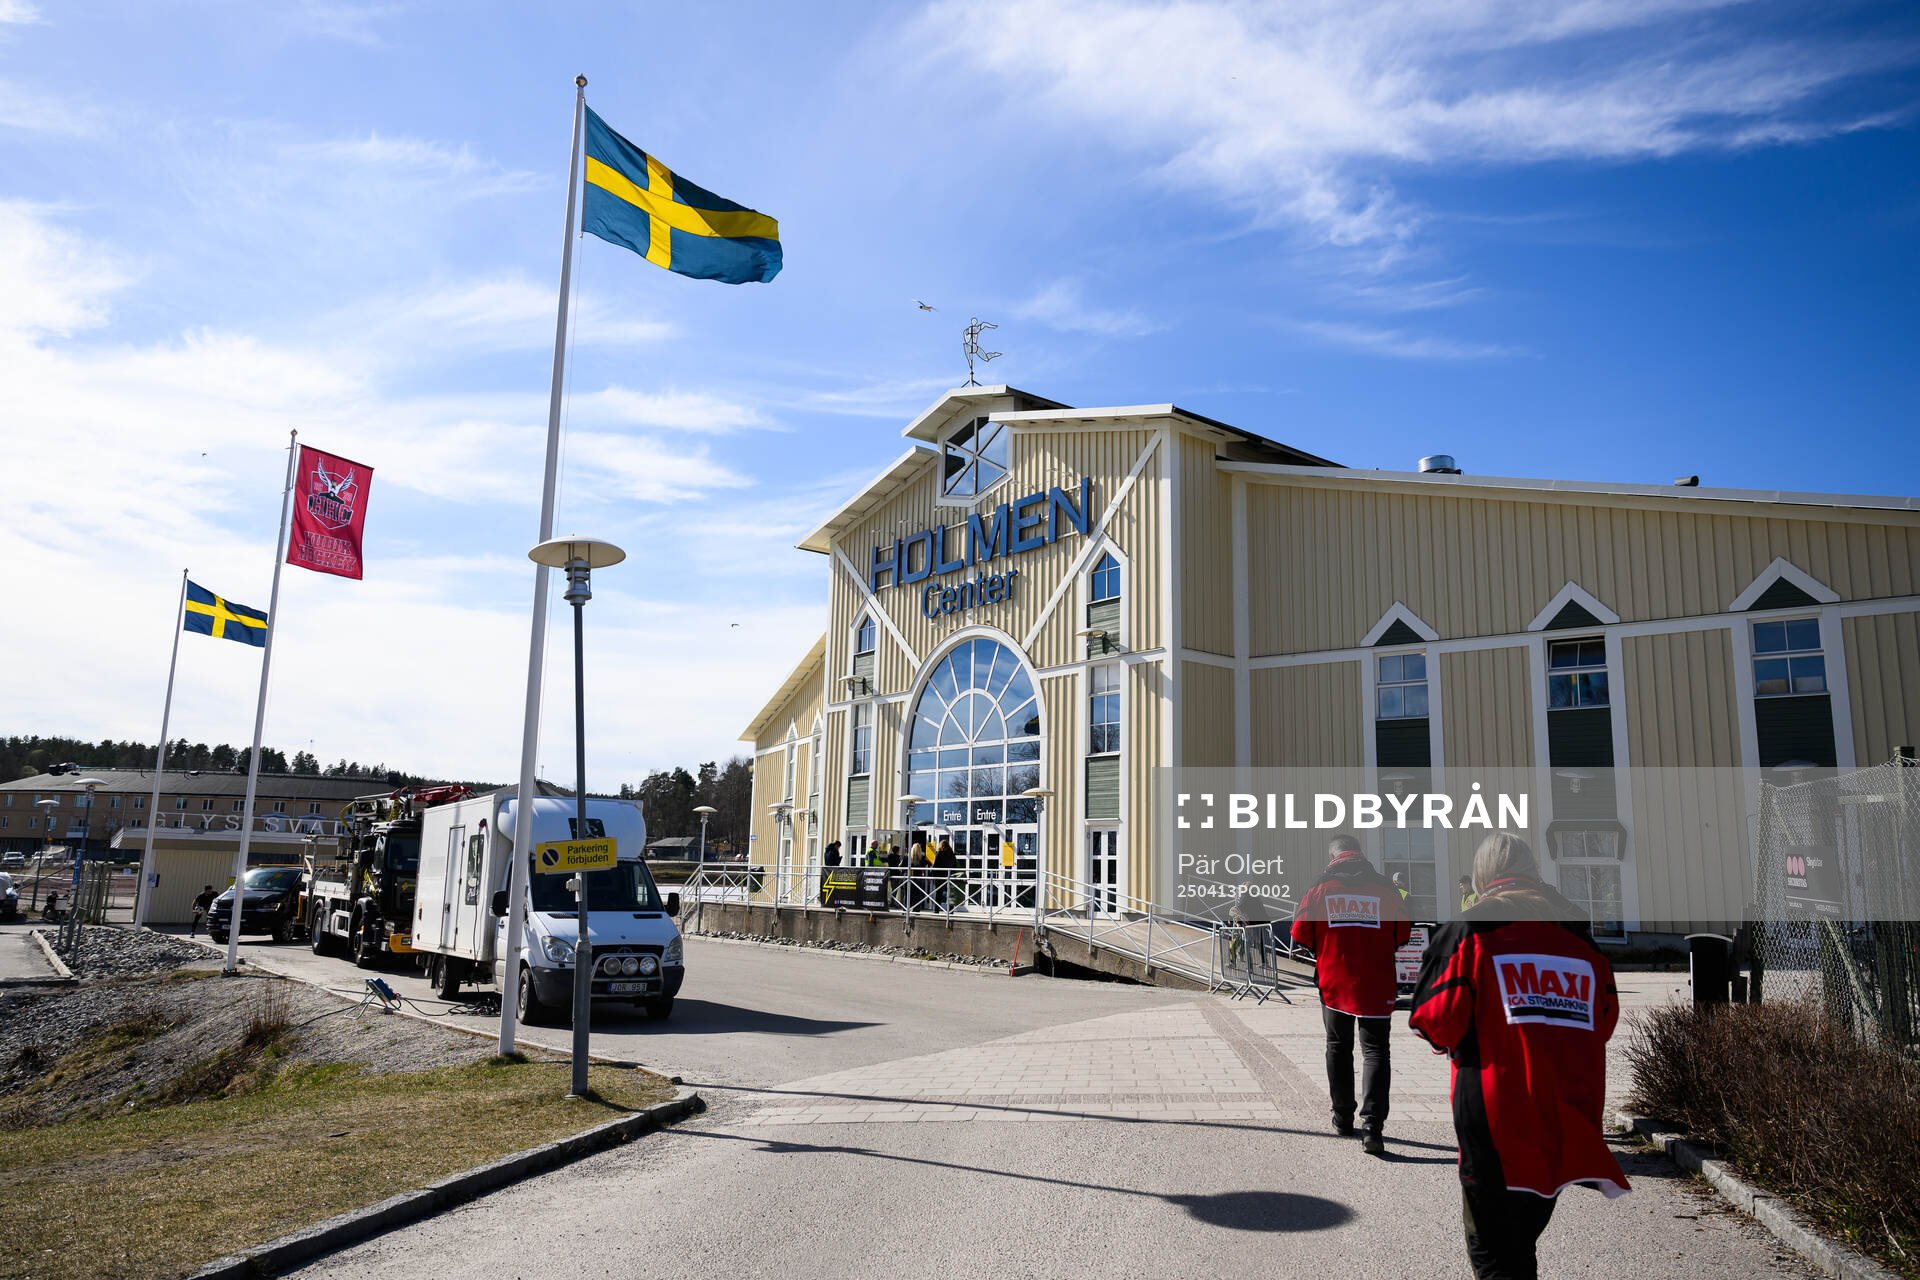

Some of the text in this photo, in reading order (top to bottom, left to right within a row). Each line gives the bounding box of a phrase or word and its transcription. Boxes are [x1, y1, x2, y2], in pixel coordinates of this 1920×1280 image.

[870, 477, 1089, 594] HOLMEN
[922, 569, 1018, 618] Center
[943, 809, 996, 821] Entré Entré
[567, 843, 608, 854] Parkering
[567, 853, 608, 864] förbjuden
[1328, 897, 1377, 914] MAXI
[1500, 963, 1590, 1002] MAXI
[1508, 996, 1588, 1012] ICA STRMARKND
